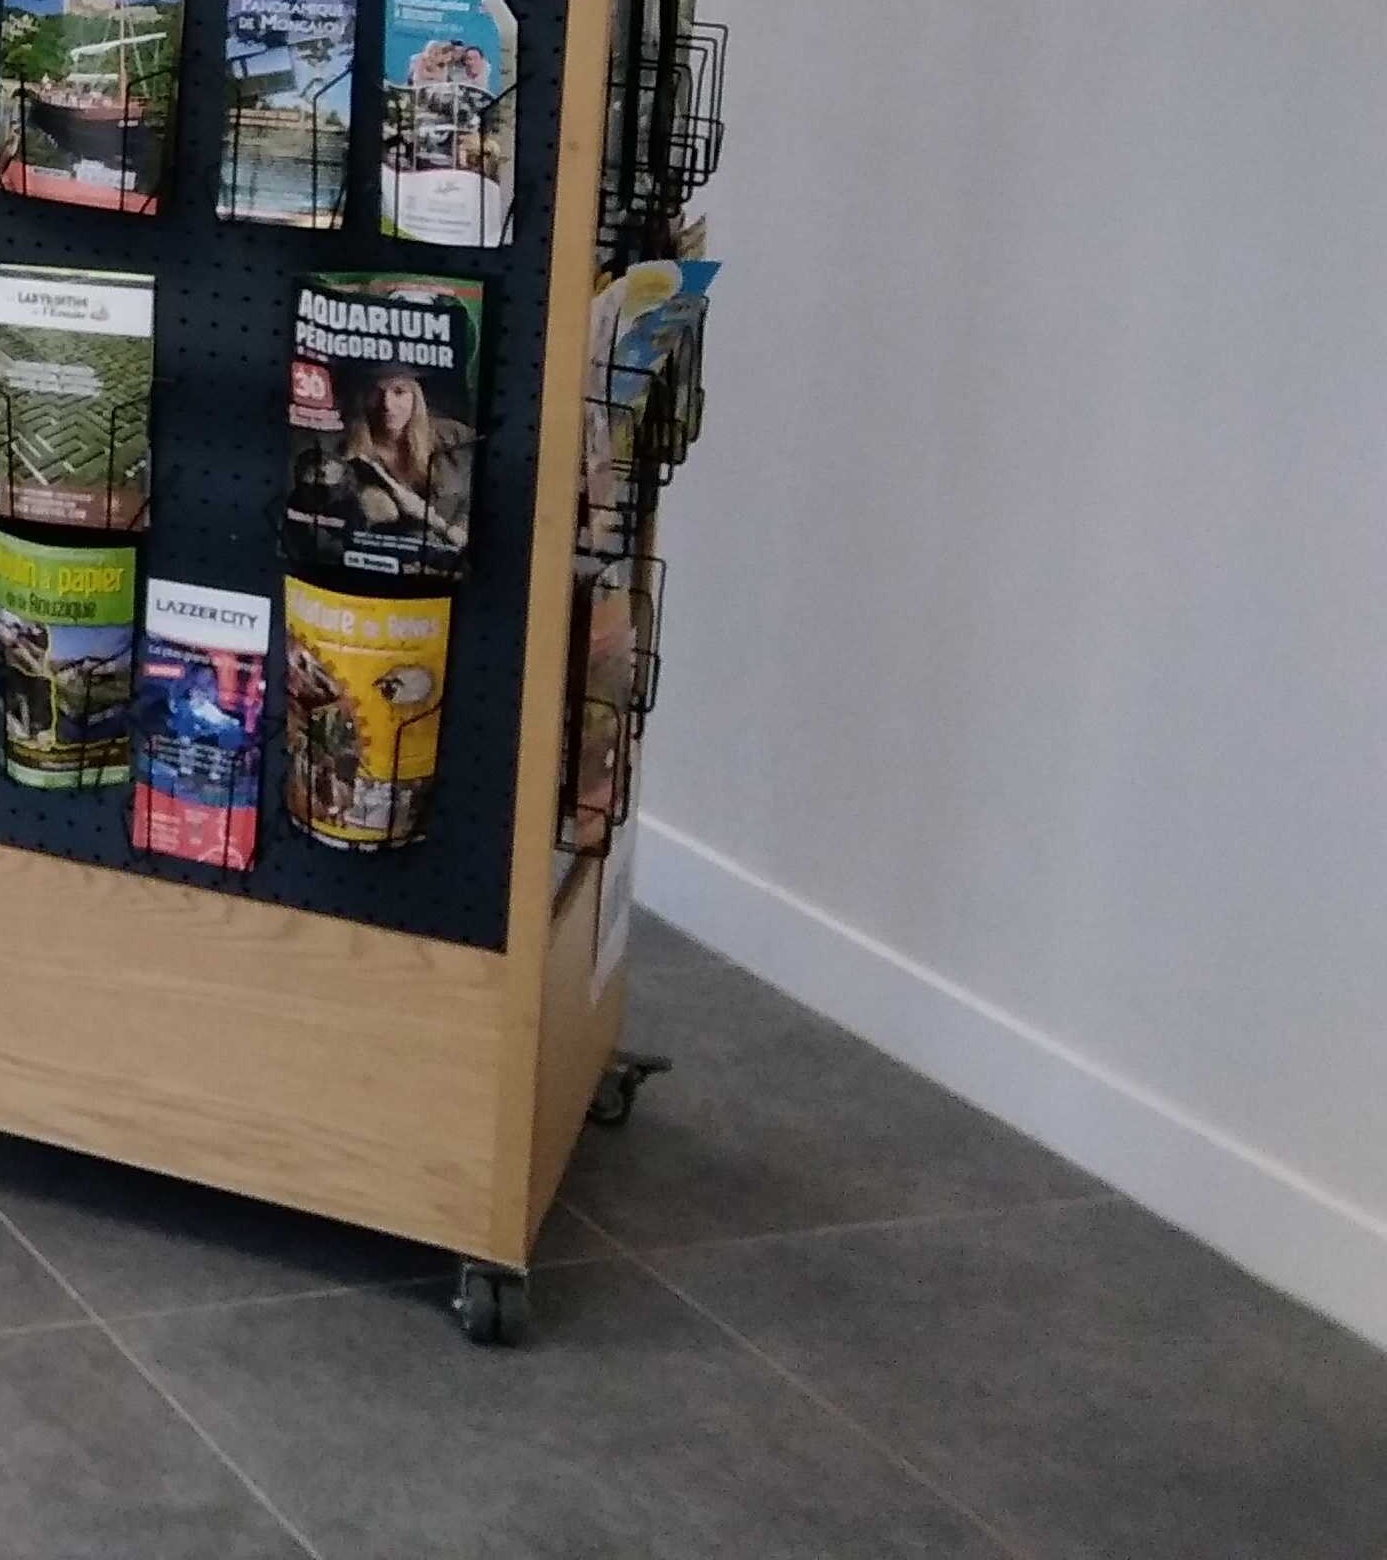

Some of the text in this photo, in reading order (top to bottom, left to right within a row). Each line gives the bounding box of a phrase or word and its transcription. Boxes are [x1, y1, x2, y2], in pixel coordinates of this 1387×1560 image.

[298, 289, 451, 342] AQUARIUM
[398, 341, 454, 369] NOIR
[58, 561, 125, 596] papier
[156, 598, 259, 630] LAZZER CITY
